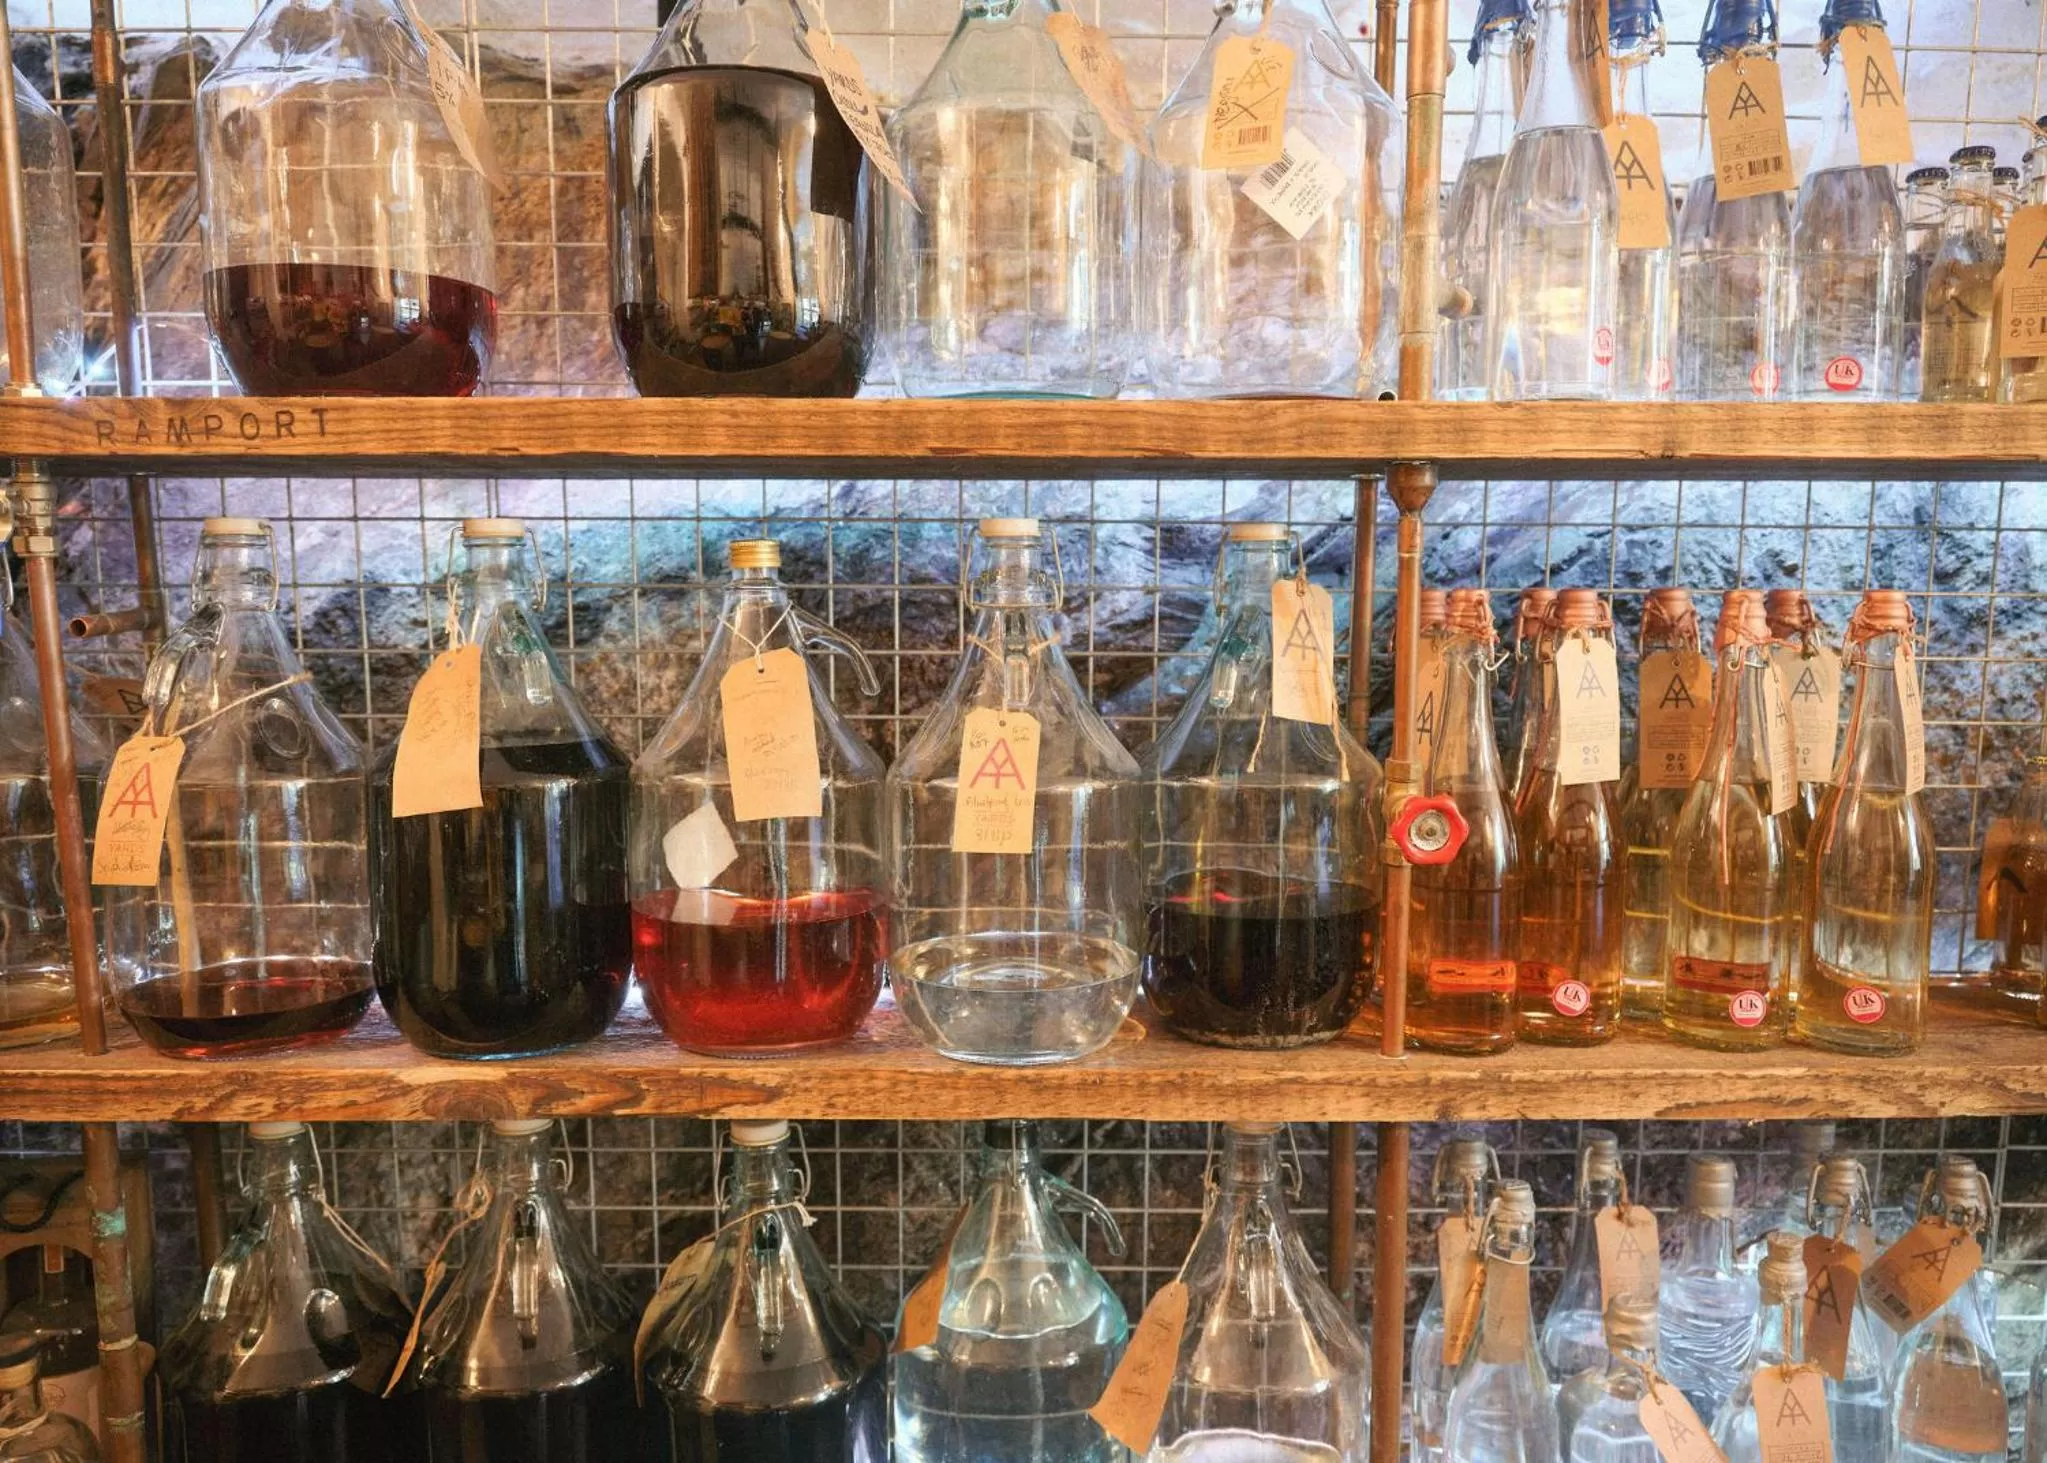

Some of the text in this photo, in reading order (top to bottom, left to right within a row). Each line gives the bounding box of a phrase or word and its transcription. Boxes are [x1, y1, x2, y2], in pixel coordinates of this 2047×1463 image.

[95, 407, 329, 447] RAMPORT
[1562, 985, 1582, 1003] UK
[1852, 993, 1876, 1009] UK
[1738, 998, 1759, 1010] UK
